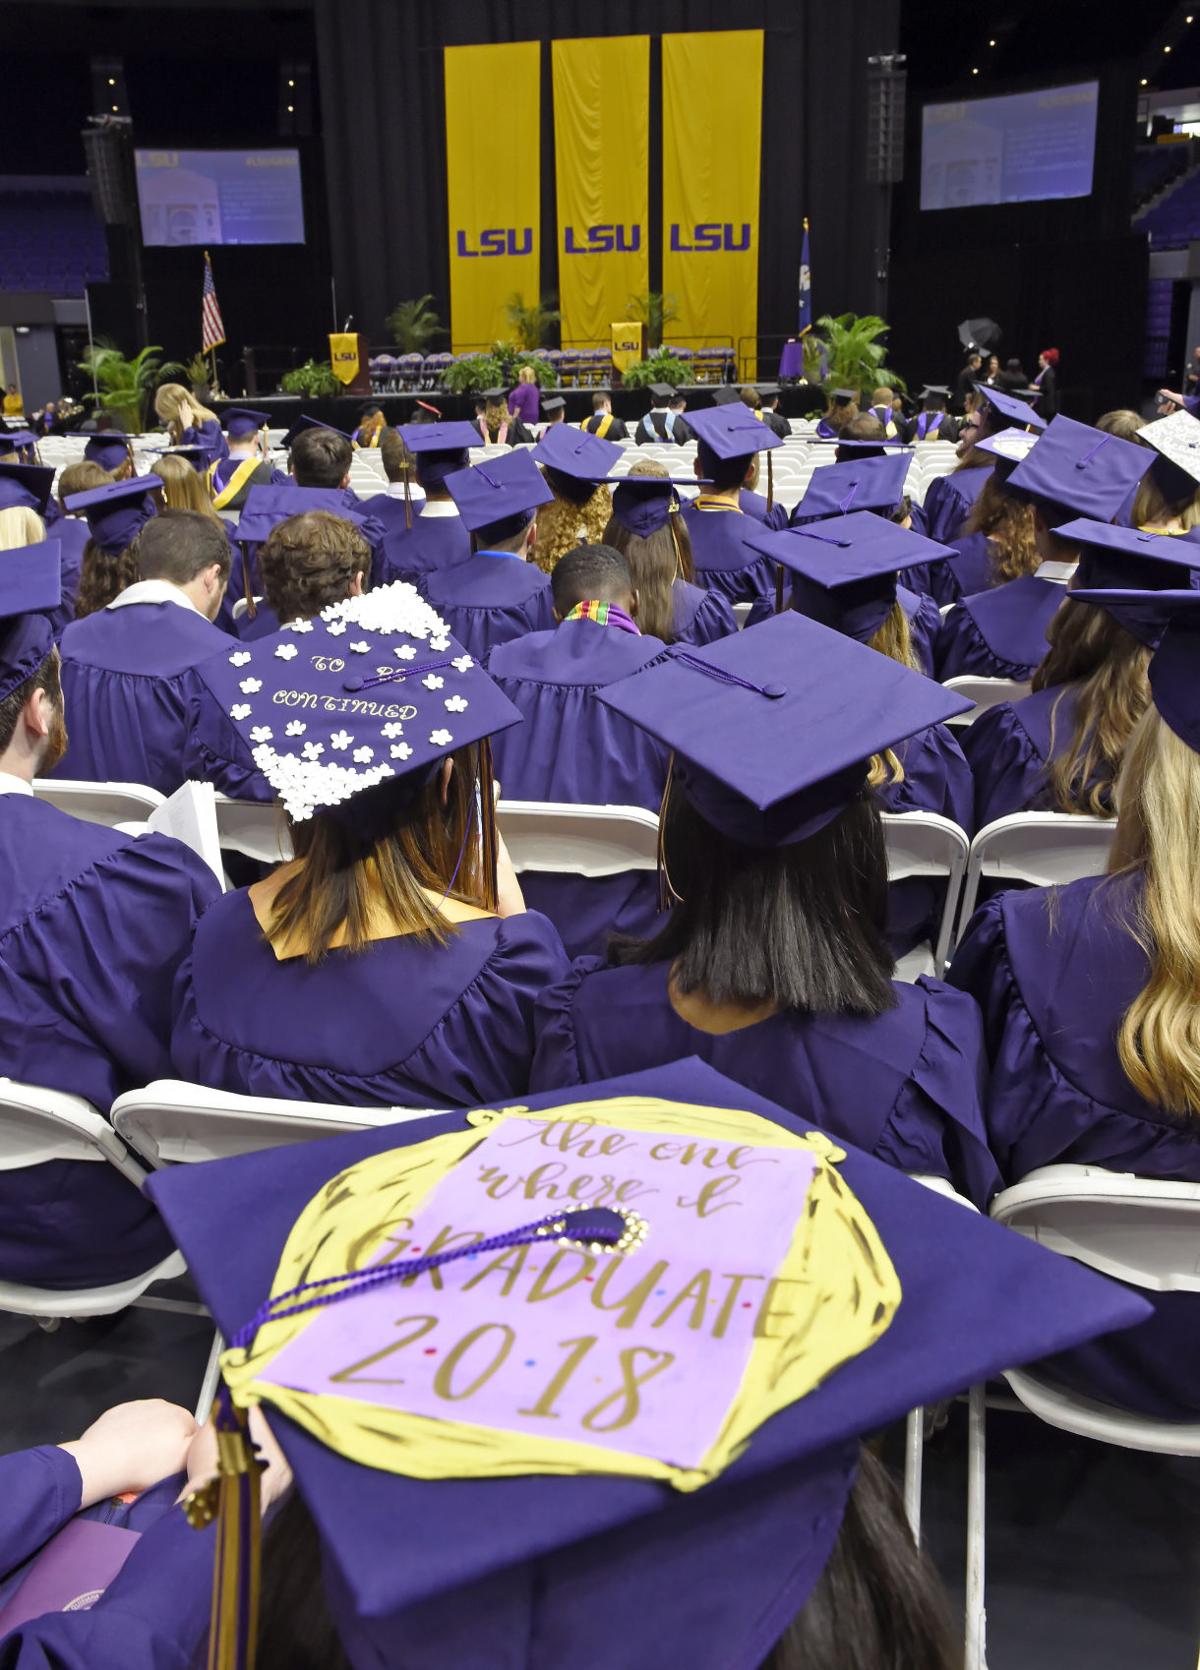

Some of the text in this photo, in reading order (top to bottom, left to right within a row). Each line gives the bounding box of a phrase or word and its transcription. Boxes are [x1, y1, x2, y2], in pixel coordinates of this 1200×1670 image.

[456, 228, 533, 257] LSU
[564, 224, 641, 254] LSU
[670, 223, 751, 252] LSU
[334, 352, 357, 361] LSU
[614, 341, 639, 351] LSU
[311, 655, 345, 673] TO
[272, 689, 418, 721] CONTINUED
[498, 1116, 780, 1170] the one
[477, 1162, 661, 1208] where
[345, 1217, 811, 1340] GRADUATE
[328, 1315, 676, 1434] 2018
